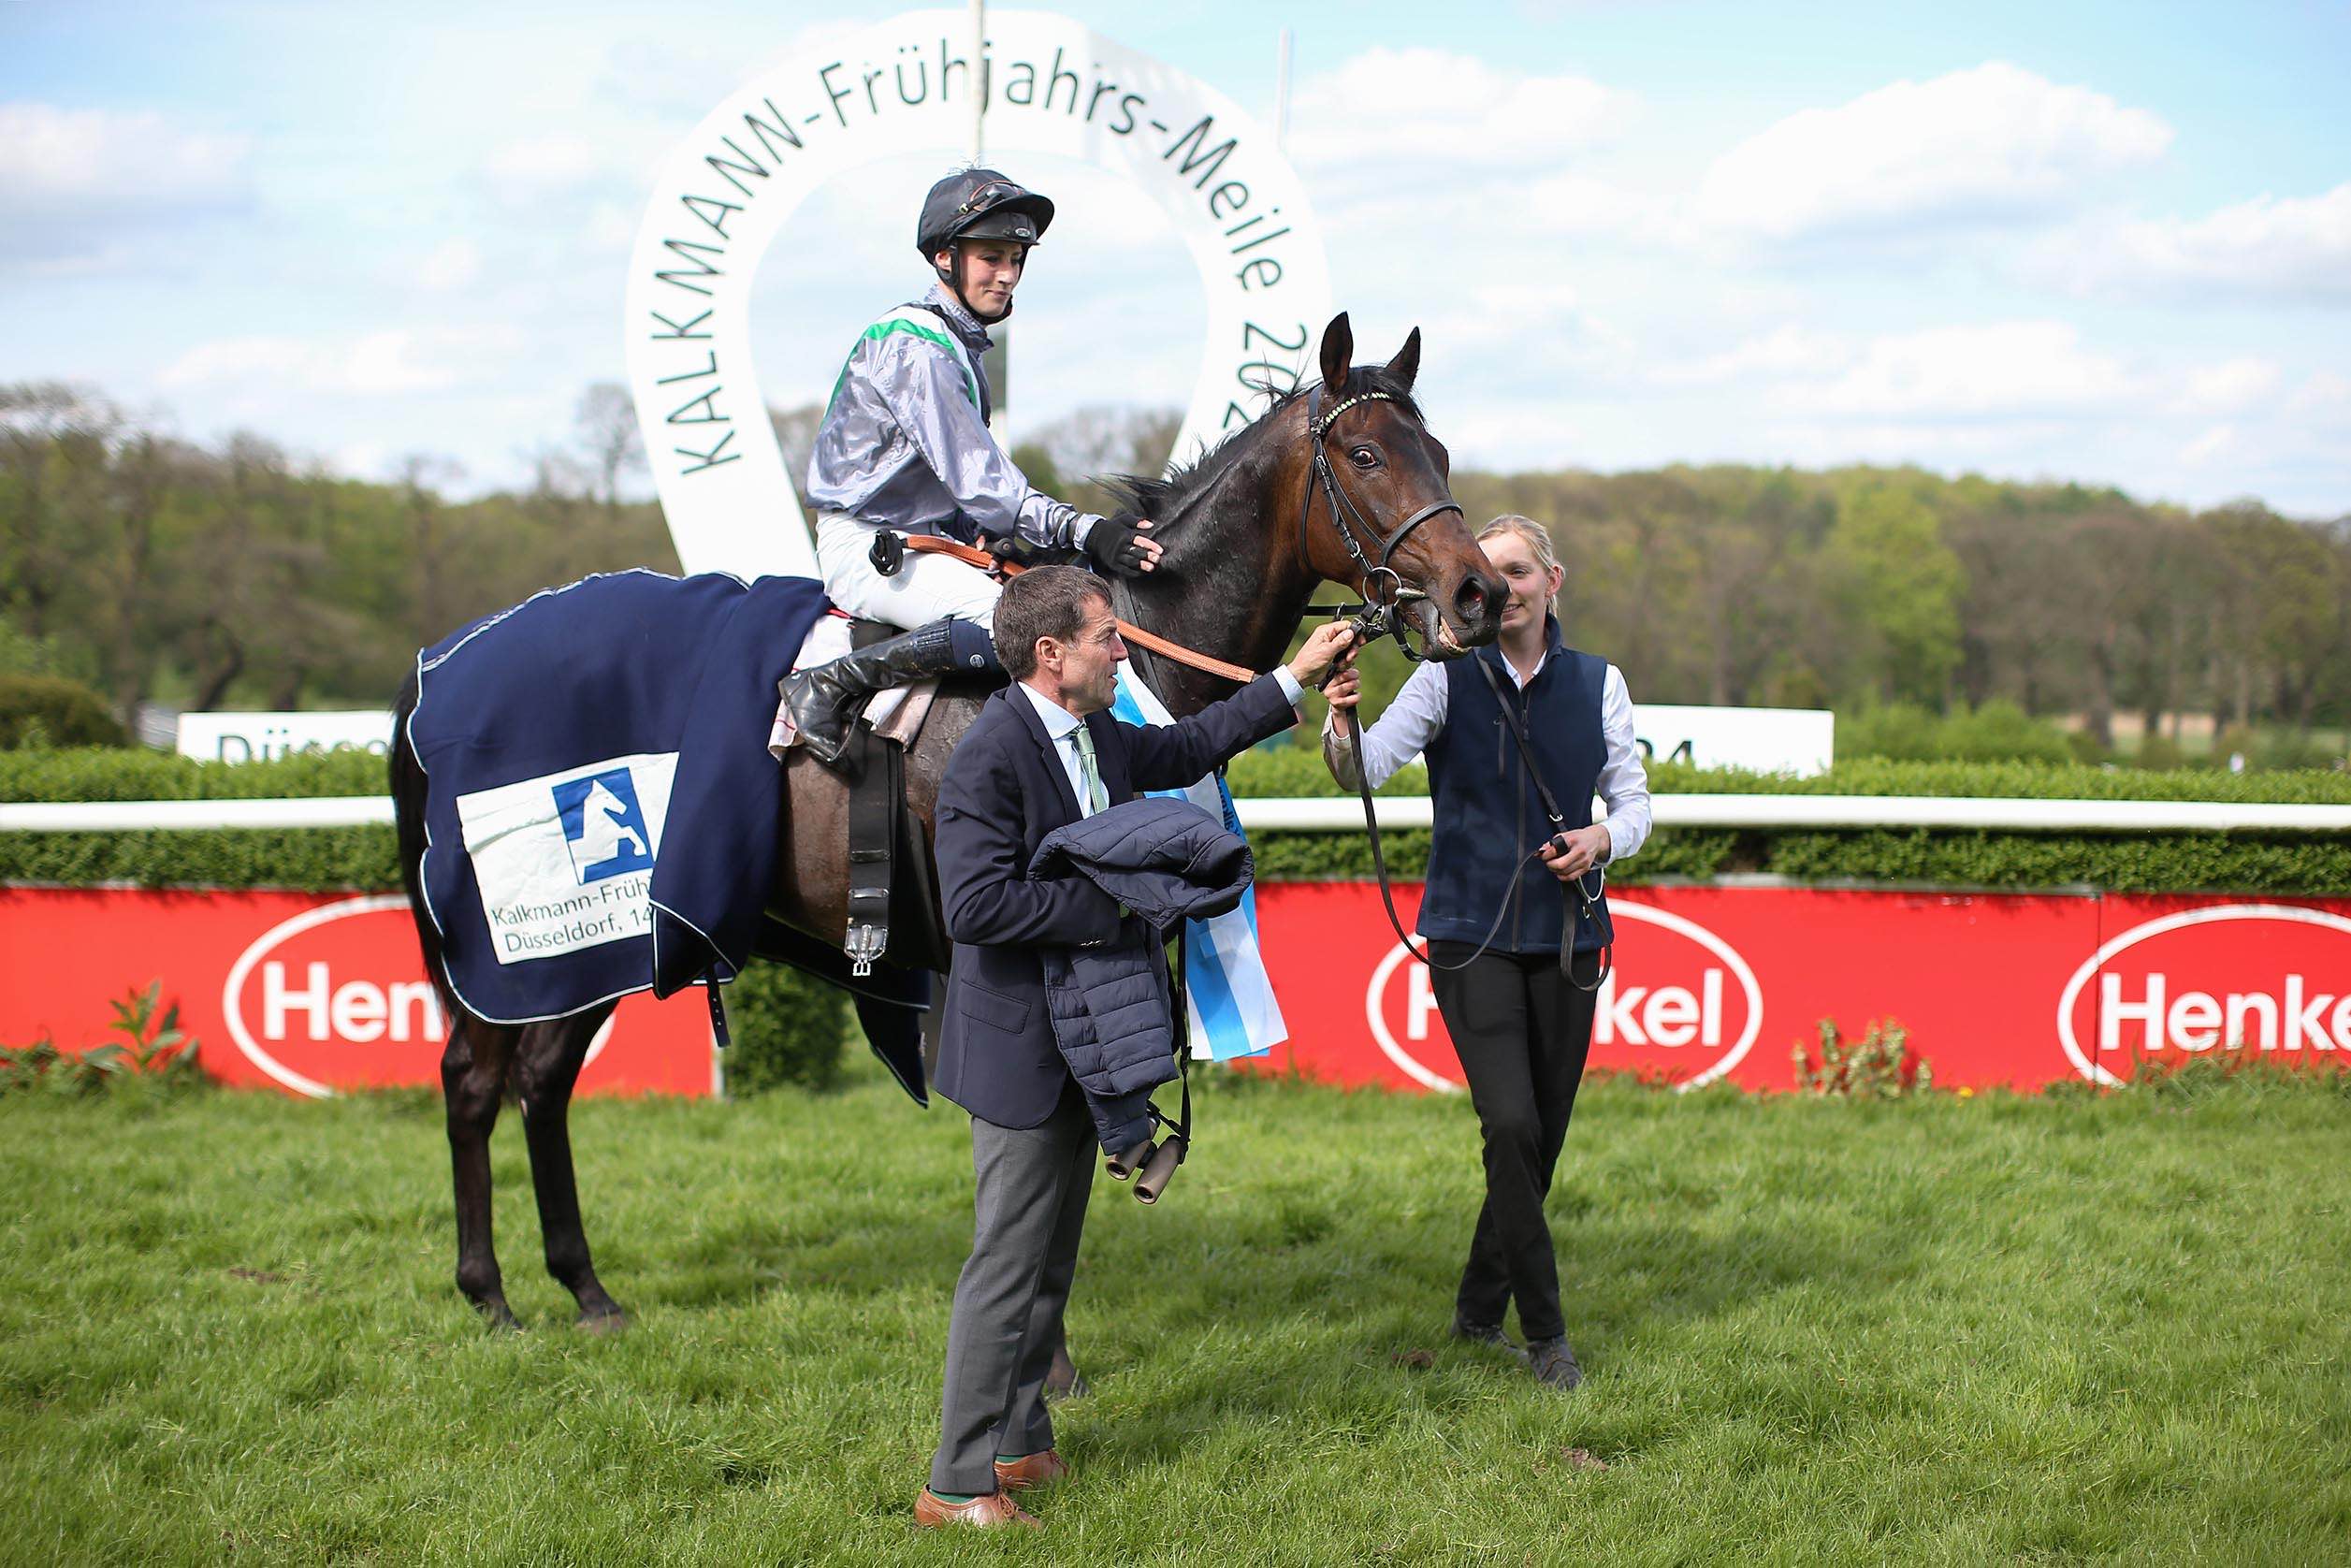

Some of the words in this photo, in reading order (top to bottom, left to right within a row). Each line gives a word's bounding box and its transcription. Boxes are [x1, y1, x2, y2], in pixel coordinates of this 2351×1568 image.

[491, 875, 652, 928] Kalkmann-Früh
[504, 913, 623, 953] Düsseldorf,
[630, 905, 652, 928] 14
[263, 960, 445, 1043] Hen
[1407, 963, 1723, 1047] Hkel
